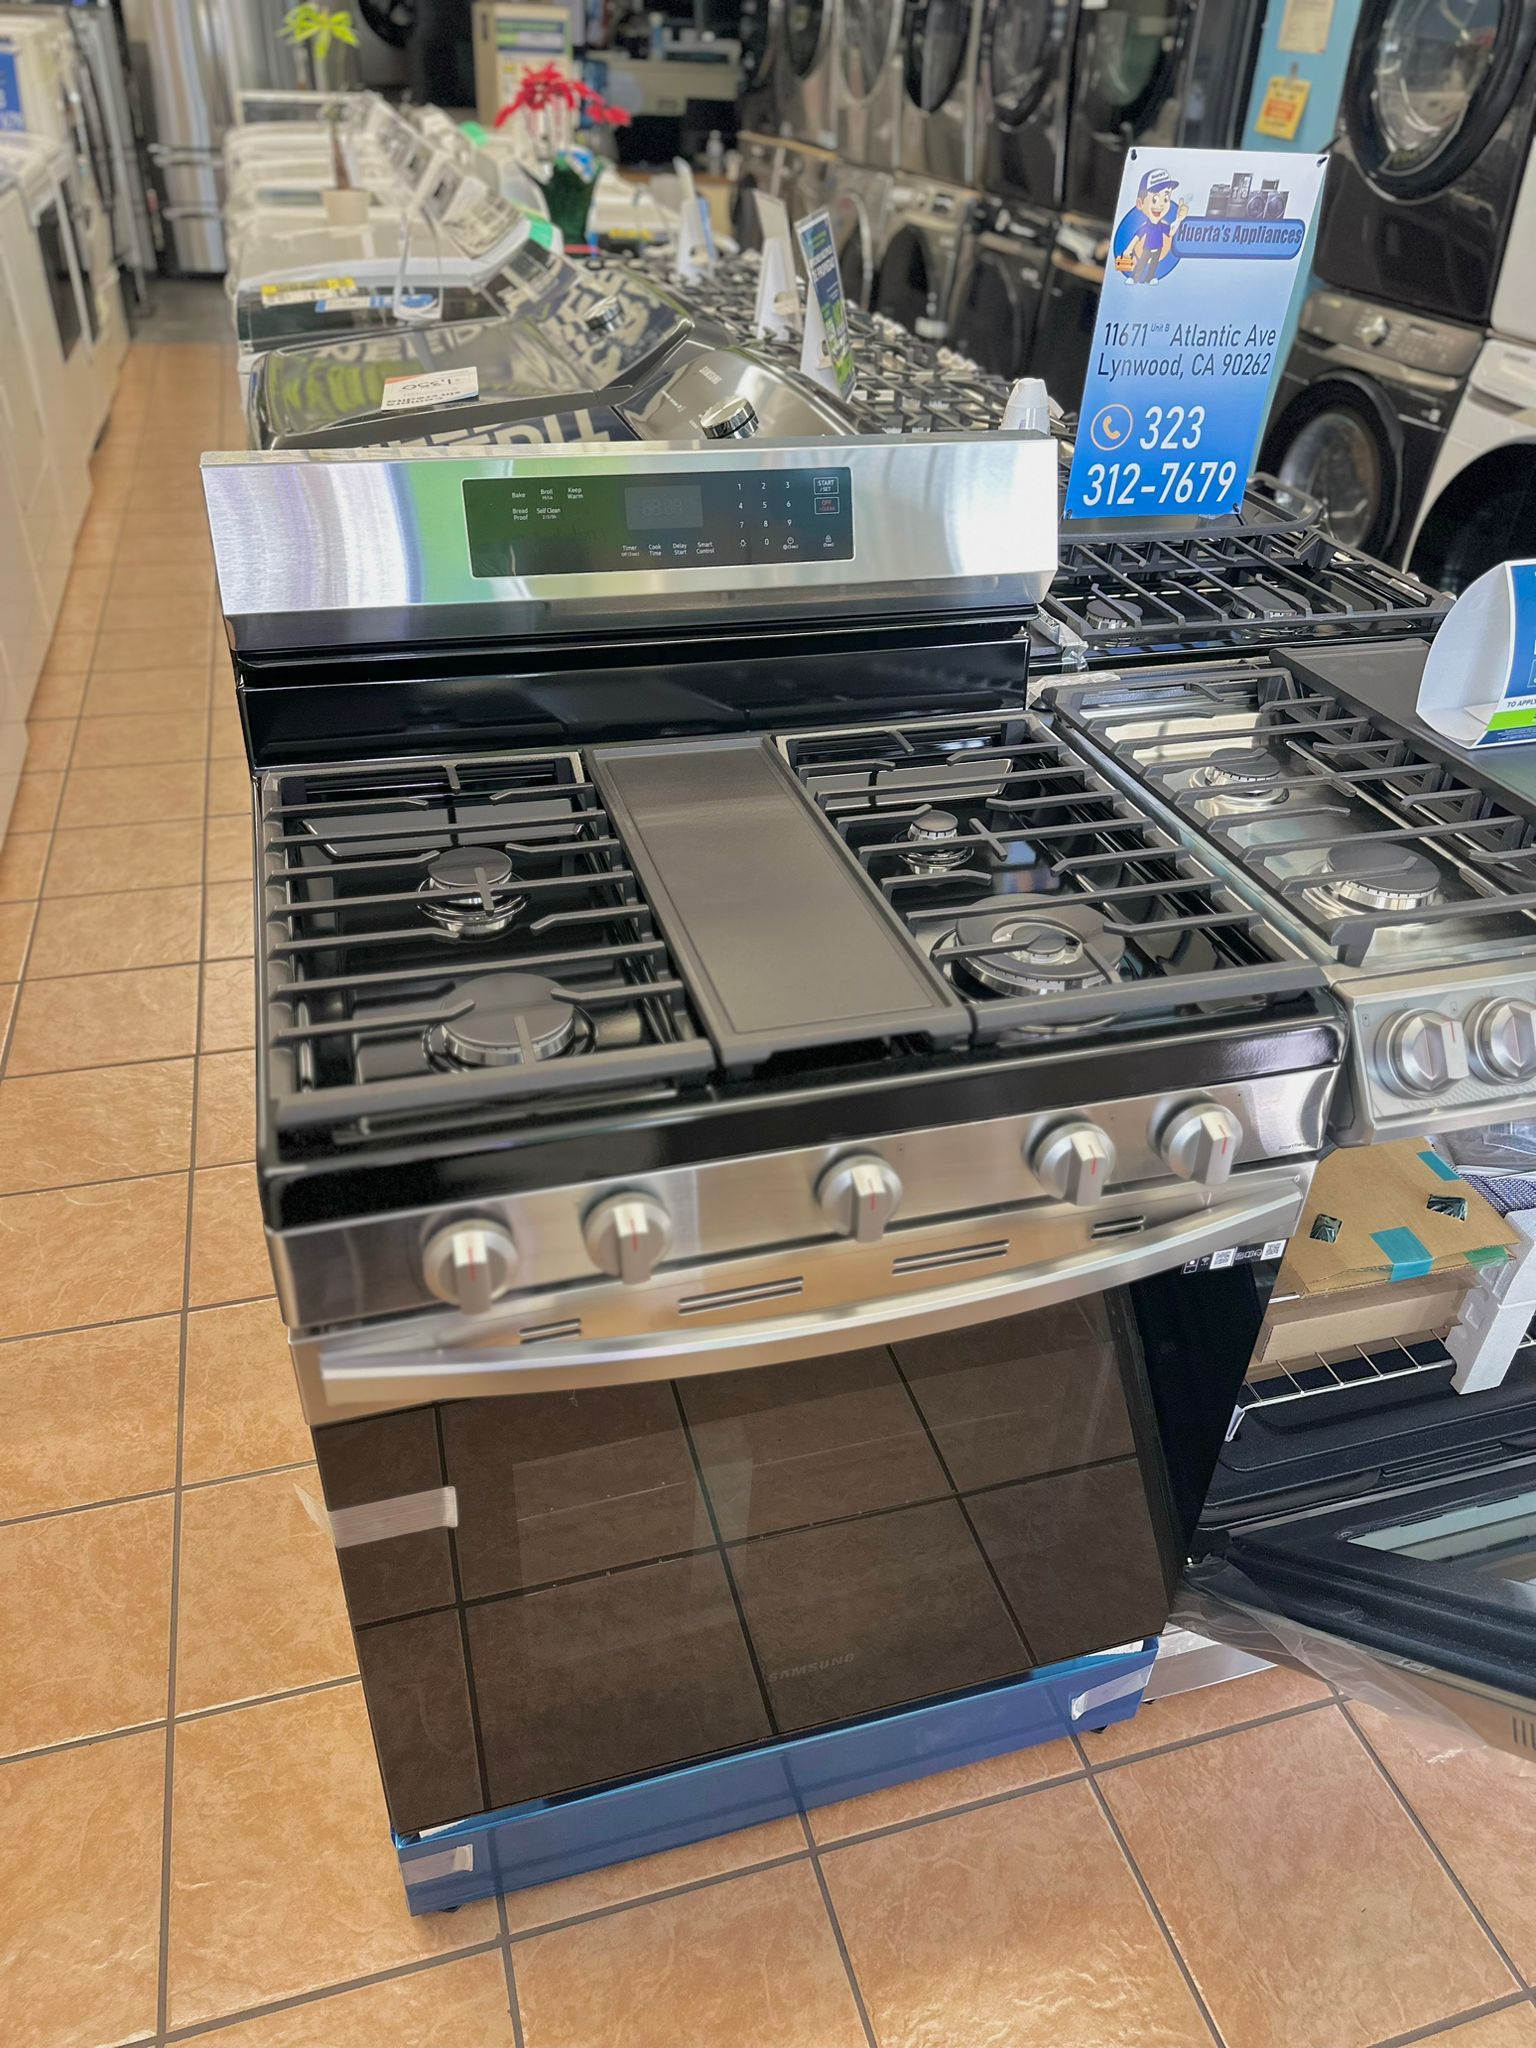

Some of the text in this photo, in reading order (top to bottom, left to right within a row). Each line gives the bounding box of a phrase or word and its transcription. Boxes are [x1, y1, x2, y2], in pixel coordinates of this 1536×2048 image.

[1176, 223, 1303, 245] Huerta's Appliances
[1104, 322, 1148, 346] 11671
[1170, 324, 1240, 347] Atlantic
[1244, 324, 1277, 347] Ave
[1097, 352, 1271, 381] Lynwood, CA 90262
[1139, 405, 1205, 450] 323
[1082, 460, 1237, 506] 312-7679
[767, 1652, 855, 1683] SAMSUNG
